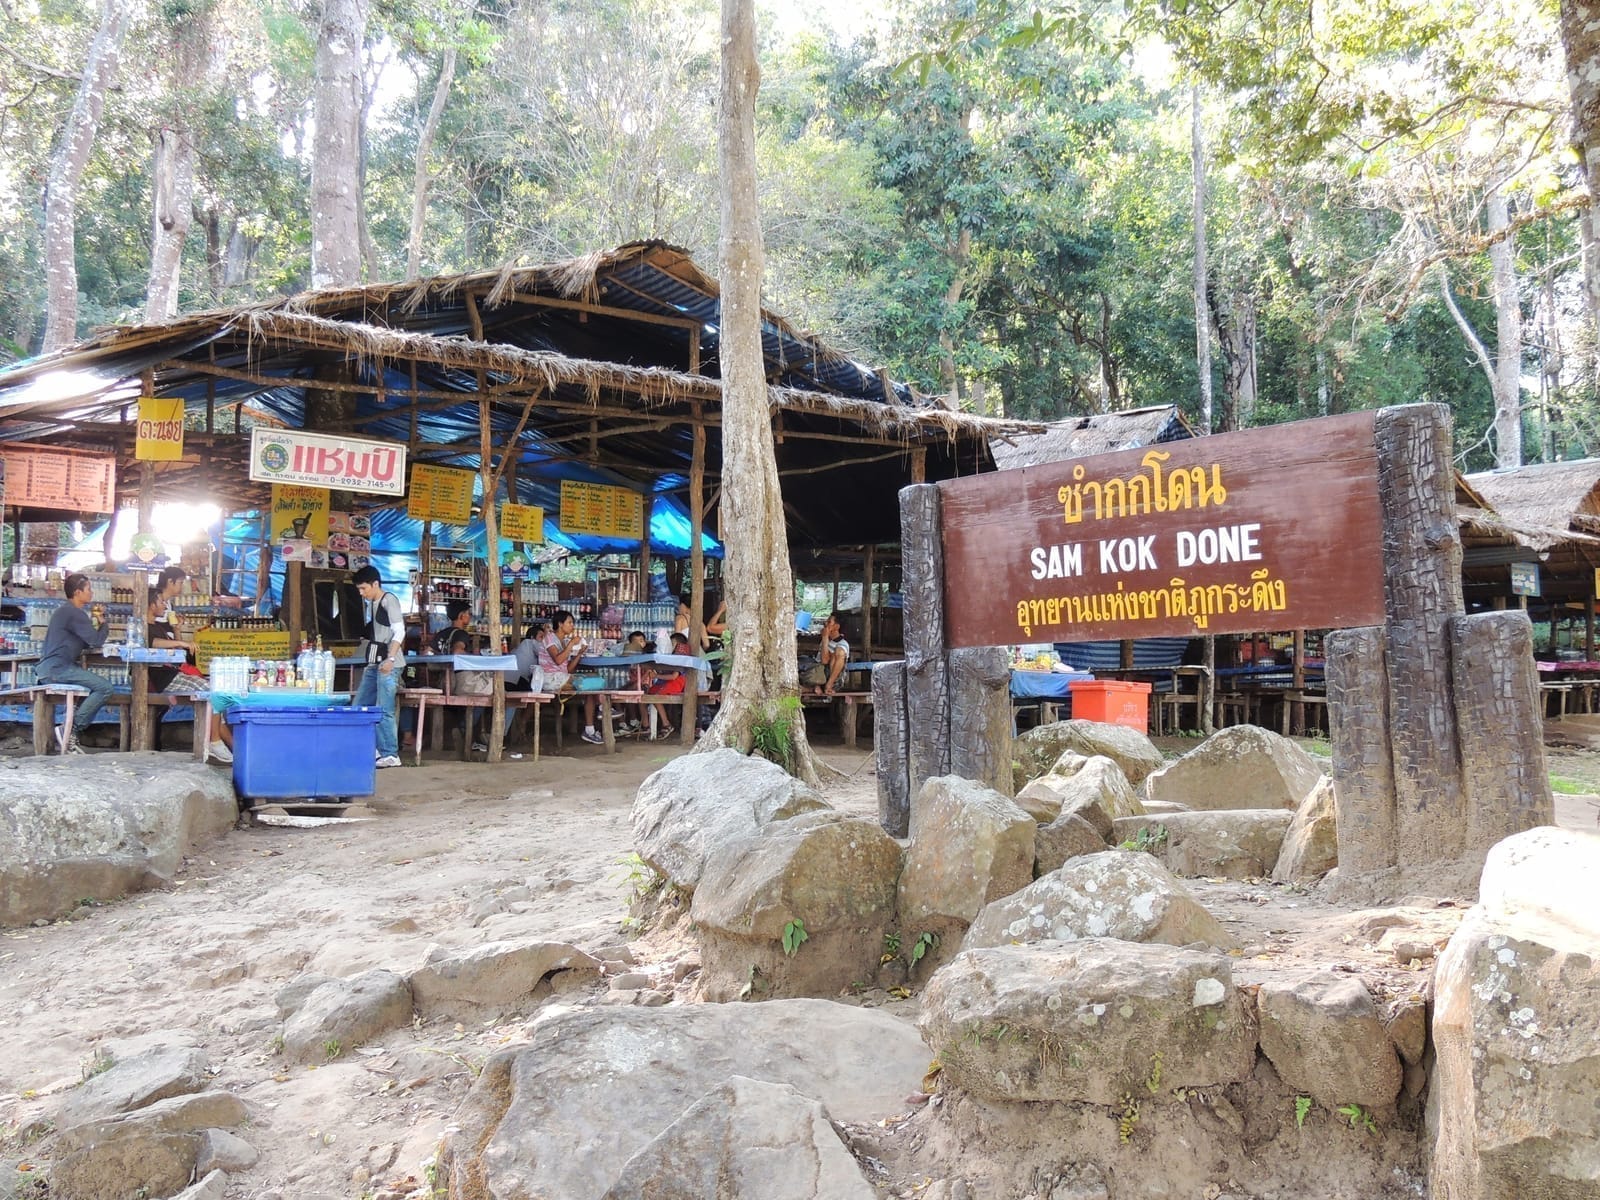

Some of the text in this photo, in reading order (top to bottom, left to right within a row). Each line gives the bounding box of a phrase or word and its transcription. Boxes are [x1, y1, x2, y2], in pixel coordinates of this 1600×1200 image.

[330, 476, 395, 489] 0-2932-7145-9
[1058, 451, 1226, 524] ซำกกโดน
[1030, 523, 1262, 580] SAM KOK DONE
[1017, 568, 1286, 637] อุทยานแห่งชาติภูกระดึง
